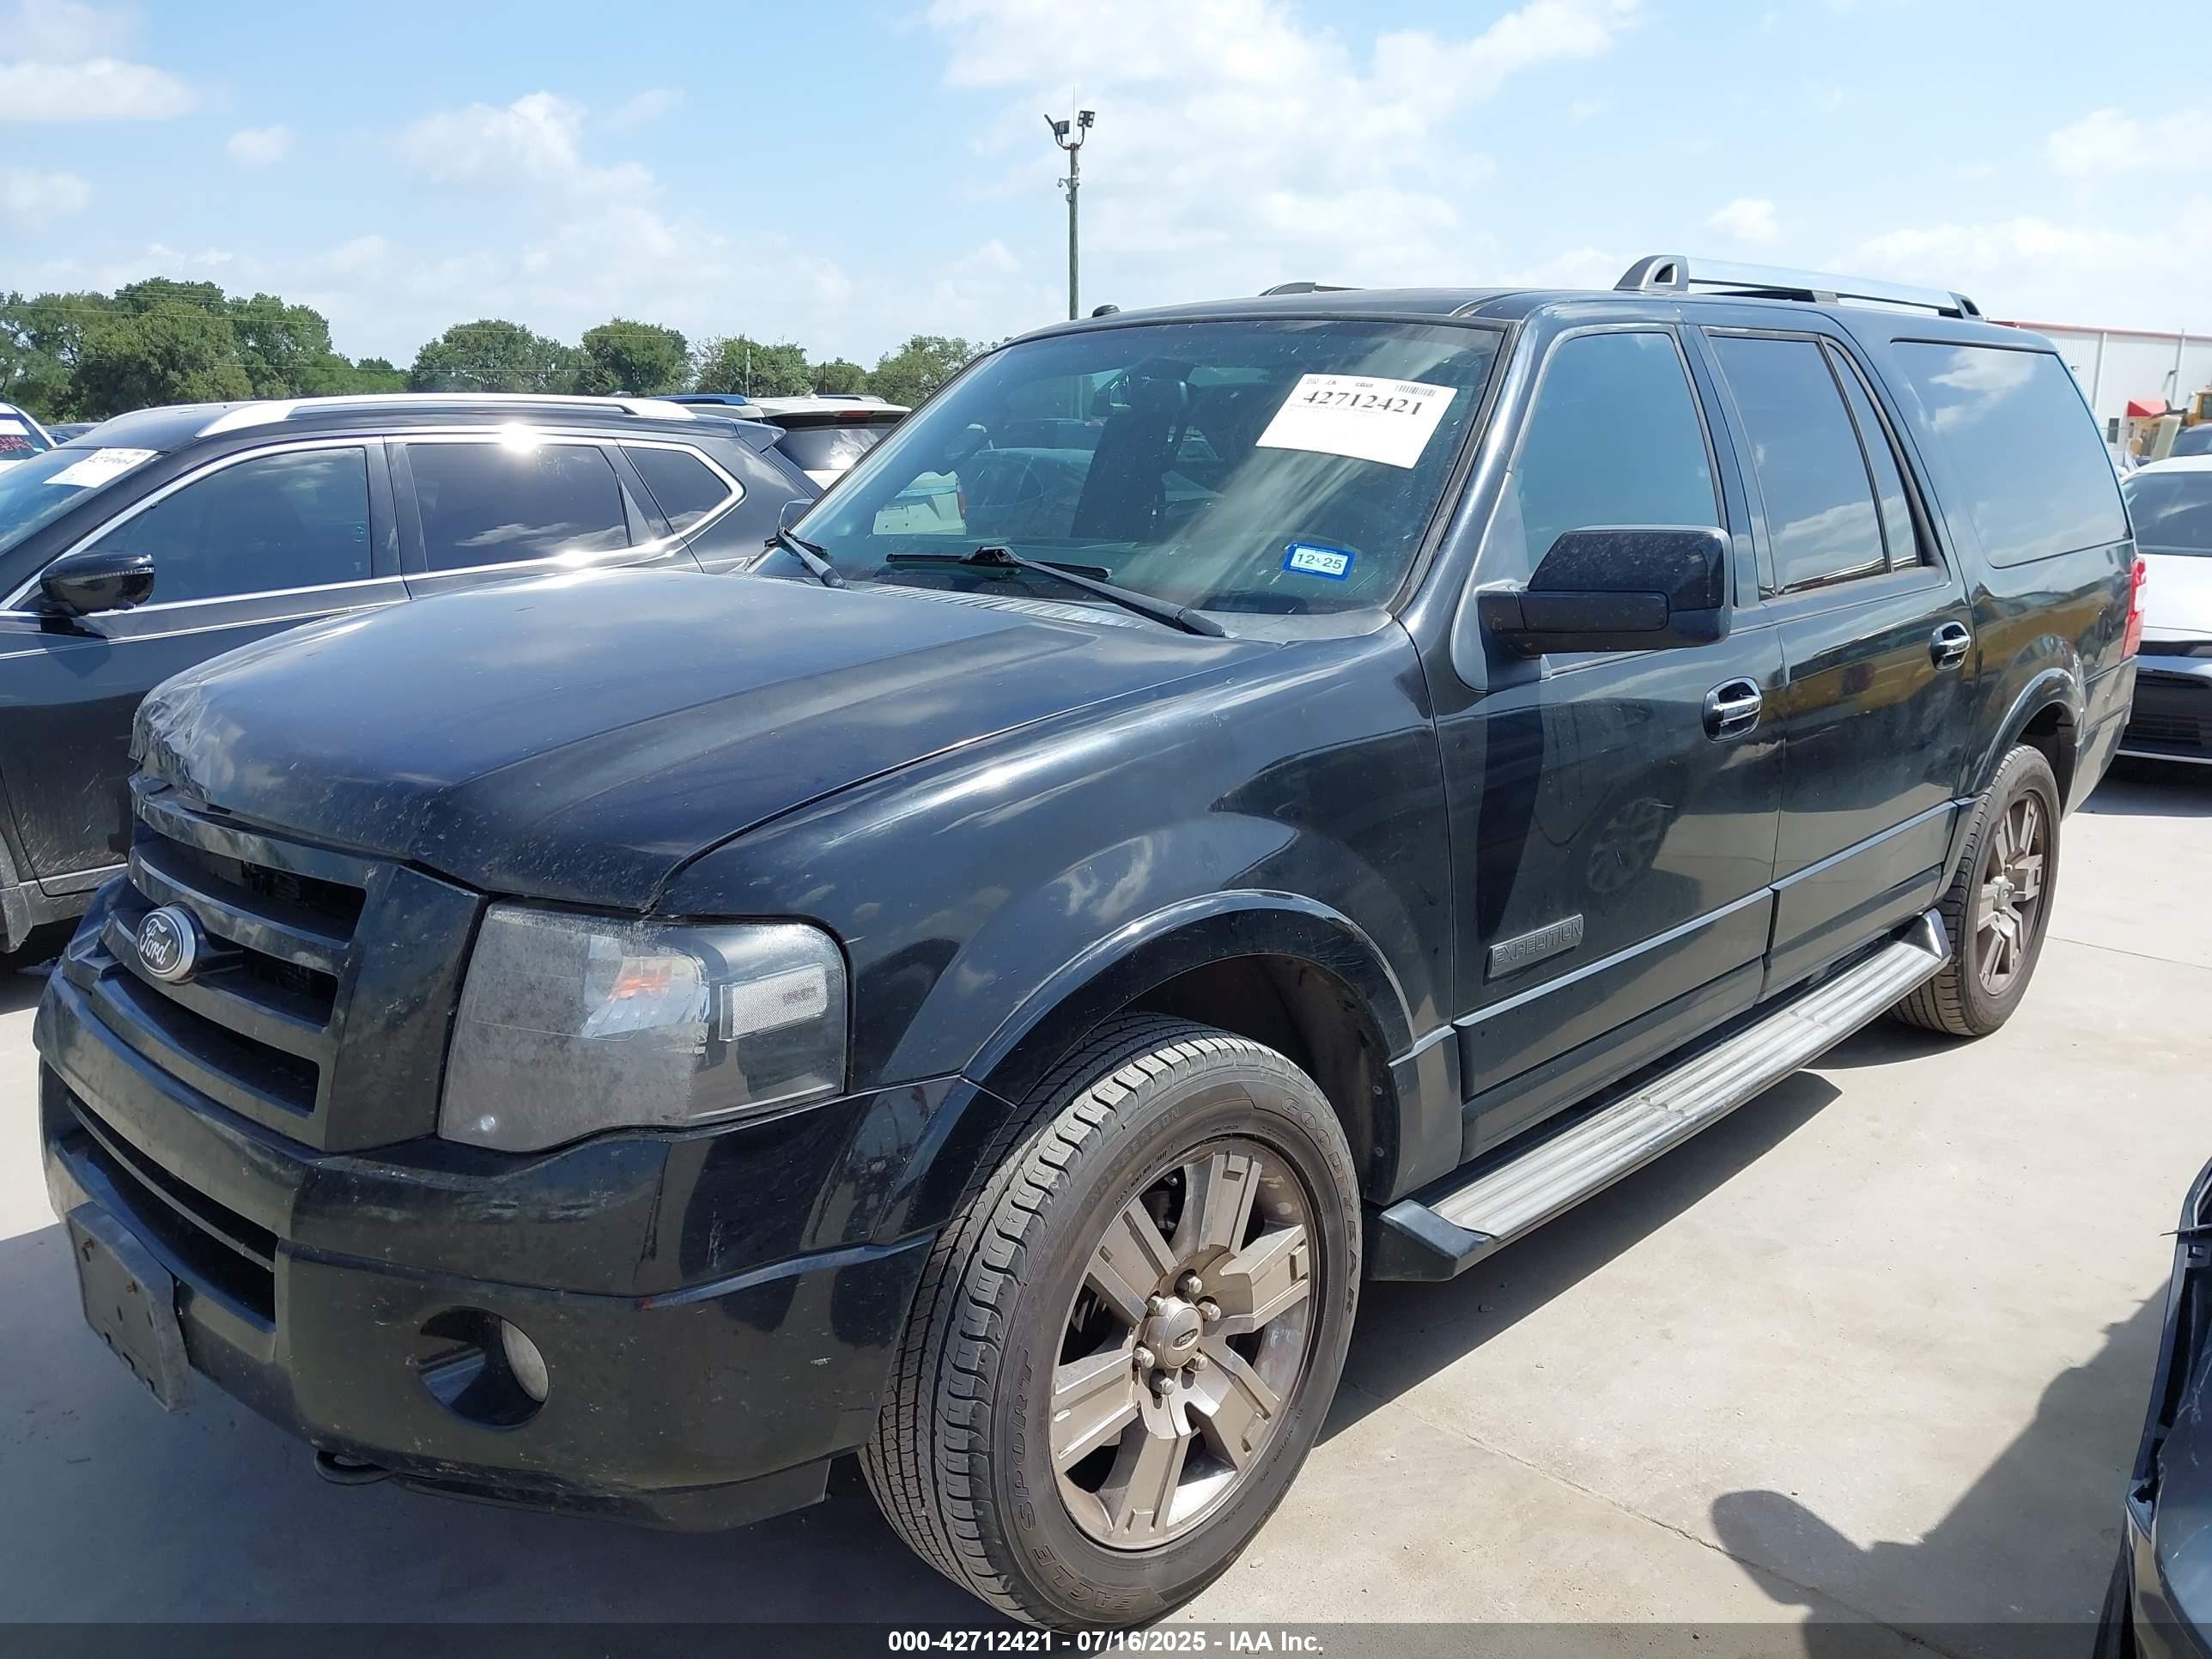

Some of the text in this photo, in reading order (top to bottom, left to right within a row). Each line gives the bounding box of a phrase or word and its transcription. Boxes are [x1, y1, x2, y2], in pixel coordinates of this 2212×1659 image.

[1303, 390, 1424, 416] 42712421
[139, 917, 172, 966] Ford
[1494, 918, 1583, 967] EXPEDITION
[1281, 1096, 1357, 1315] GOODYEAR
[1012, 1346, 1141, 1610] EAGLE SPORT
